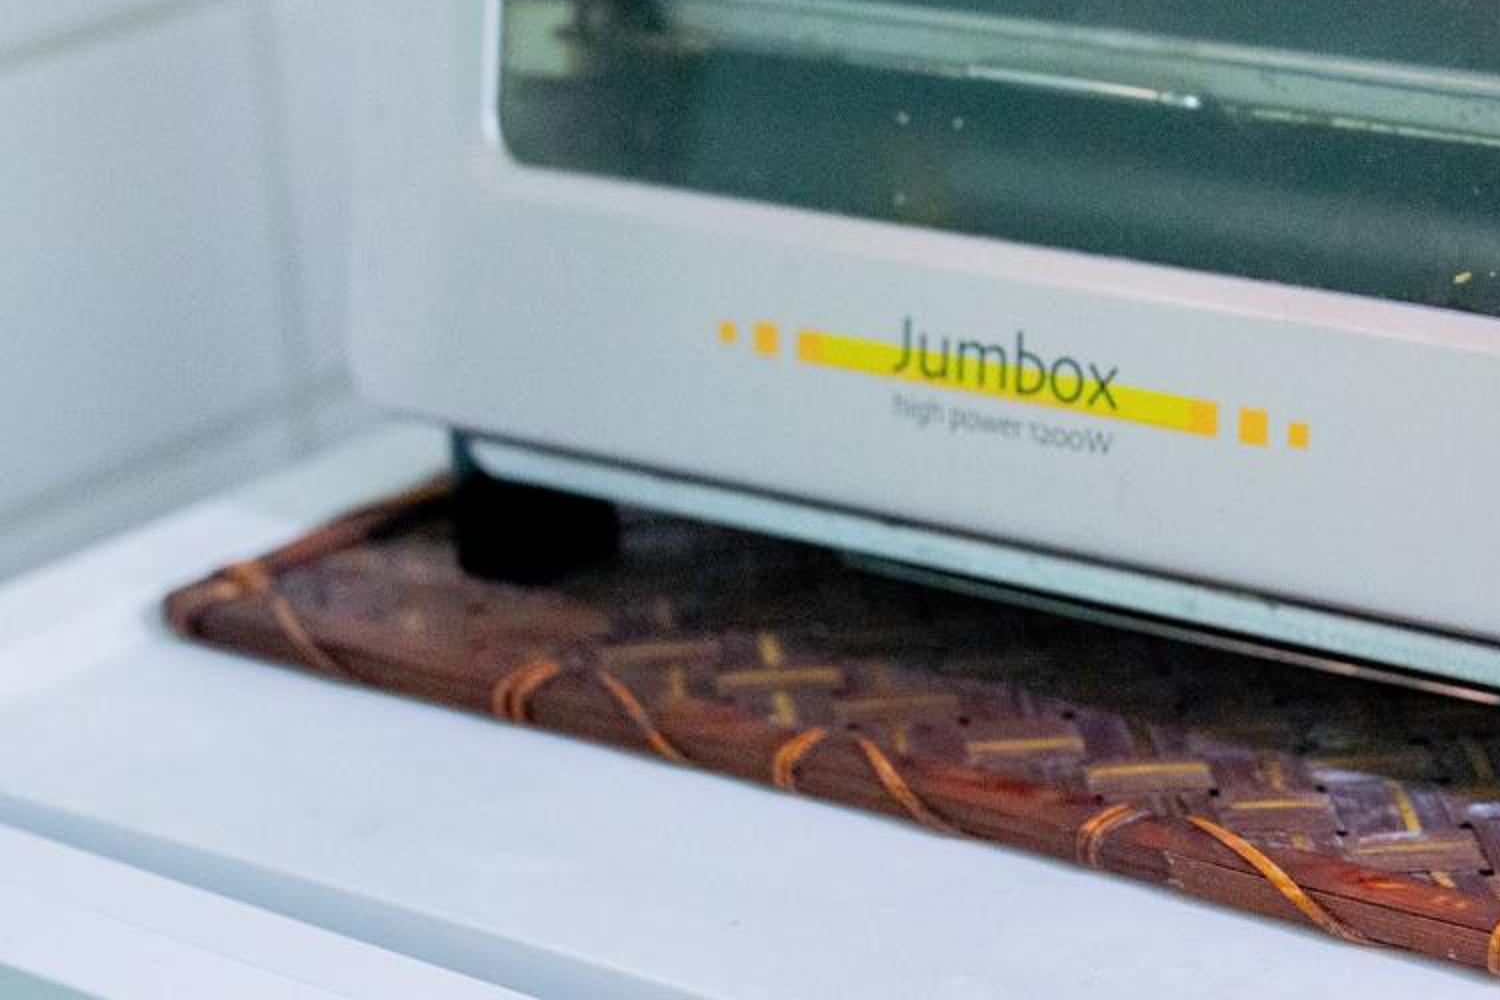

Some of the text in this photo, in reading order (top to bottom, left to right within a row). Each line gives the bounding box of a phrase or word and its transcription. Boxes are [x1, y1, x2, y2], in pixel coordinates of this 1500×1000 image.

[894, 316, 1120, 410] Jumbox
[894, 392, 945, 429] high
[949, 405, 1022, 439] power
